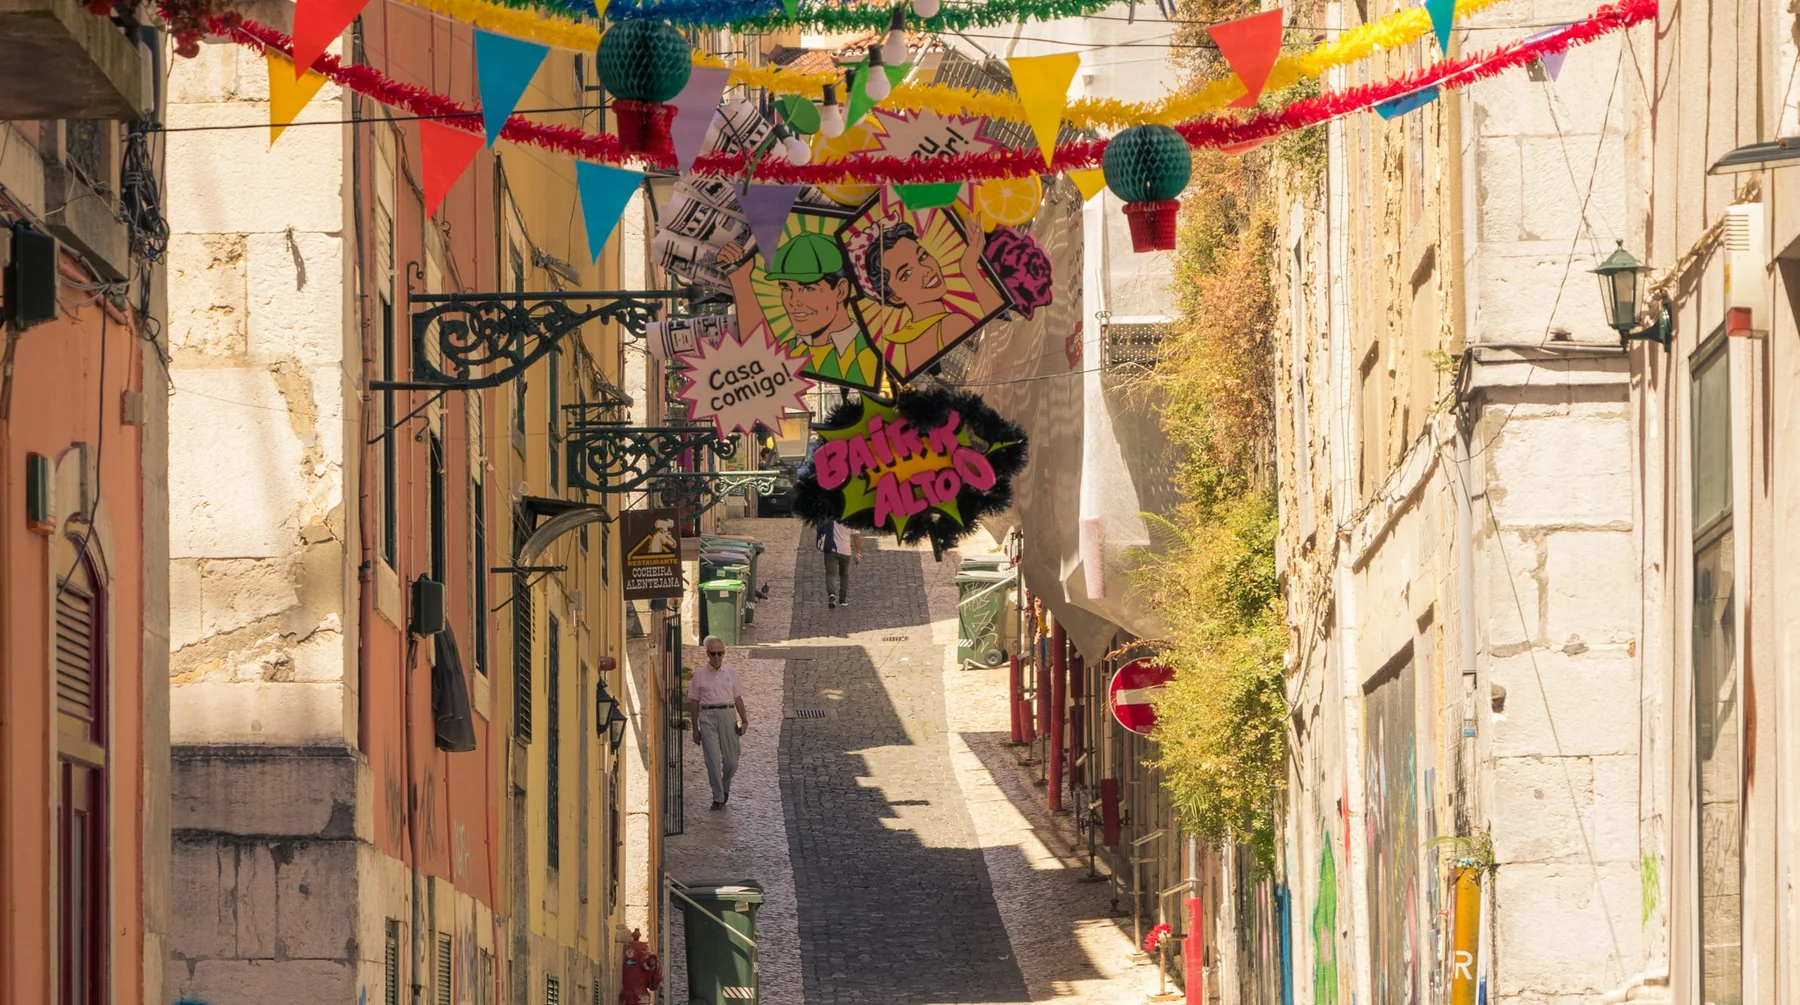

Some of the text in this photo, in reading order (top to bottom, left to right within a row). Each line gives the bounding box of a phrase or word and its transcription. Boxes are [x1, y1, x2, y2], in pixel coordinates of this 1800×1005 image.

[709, 360, 765, 391] Casa
[710, 362, 793, 411] comigo!
[874, 468, 961, 528] ALTO
[626, 578, 680, 589] ALENTEJANA
[632, 566, 673, 577] COCHEIRA
